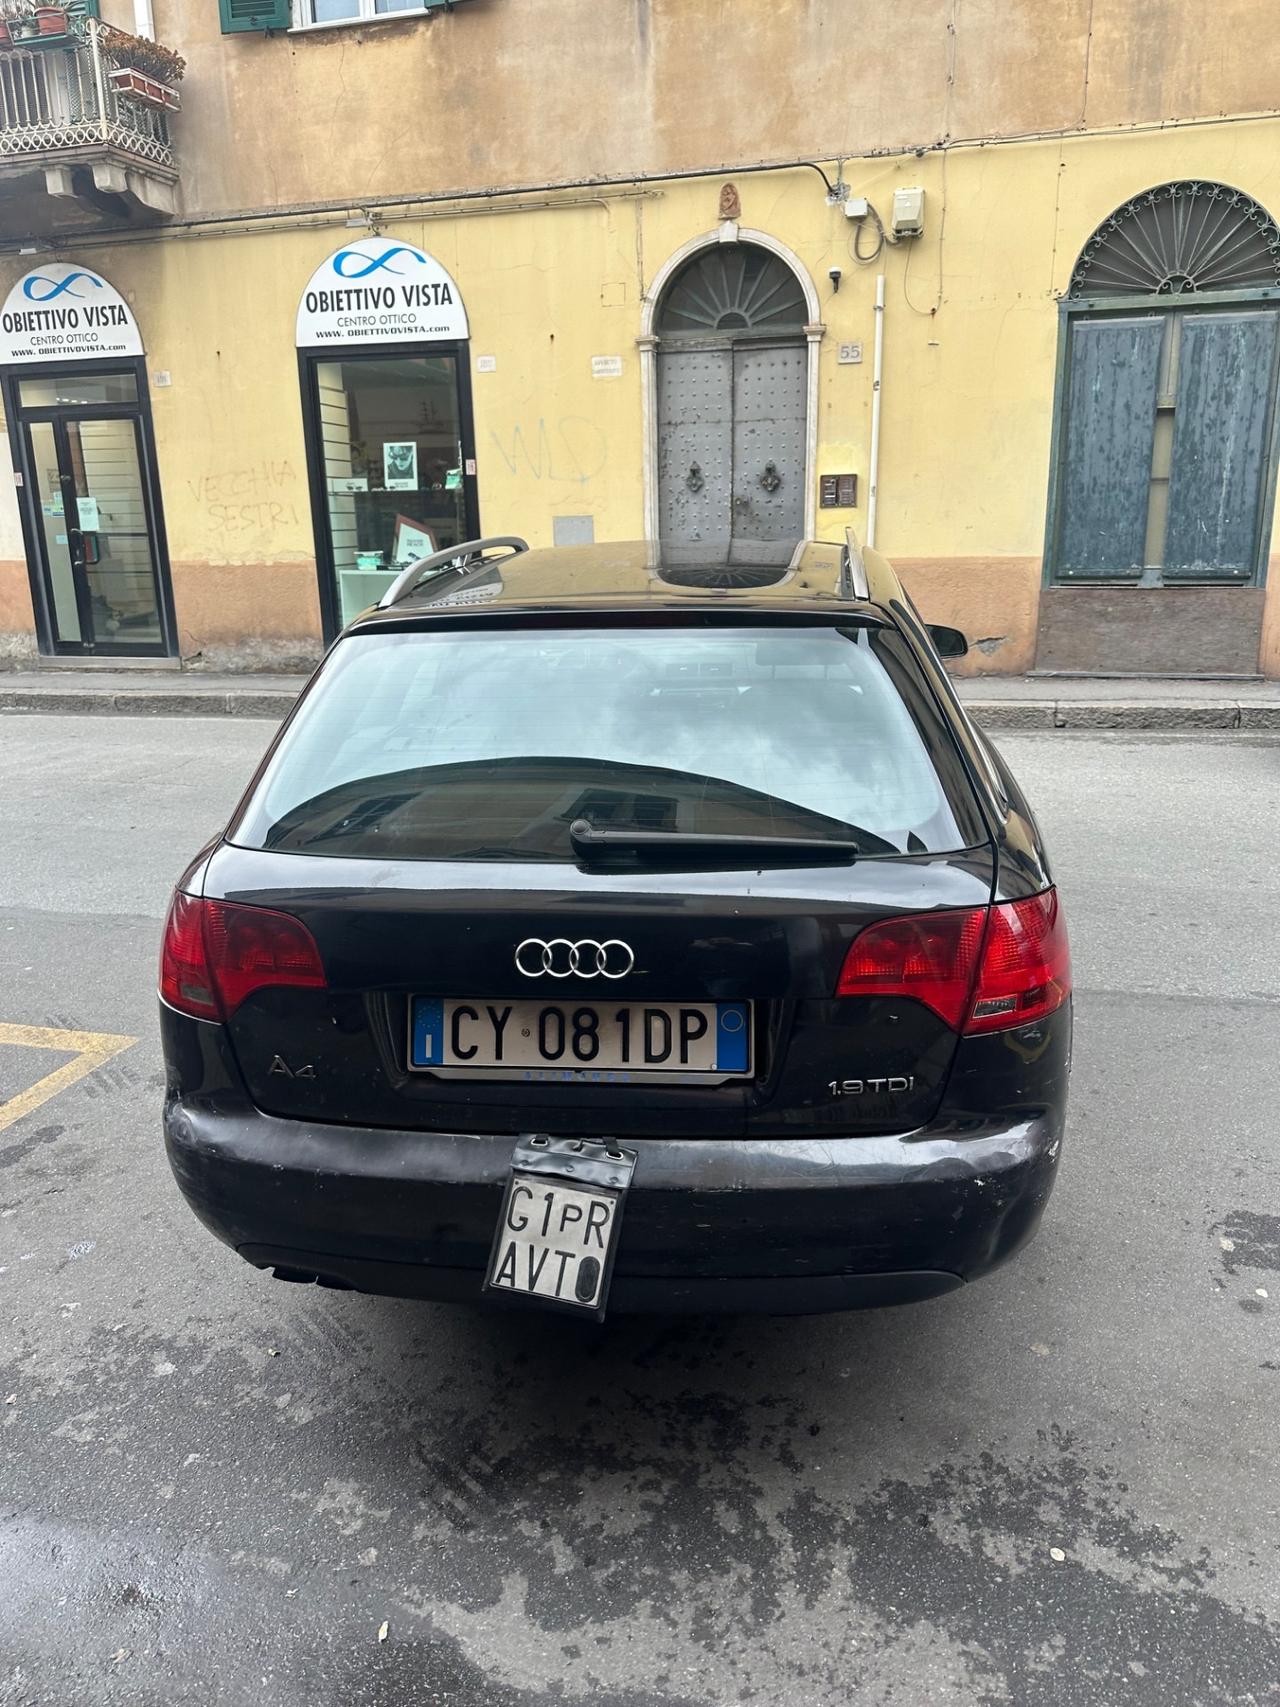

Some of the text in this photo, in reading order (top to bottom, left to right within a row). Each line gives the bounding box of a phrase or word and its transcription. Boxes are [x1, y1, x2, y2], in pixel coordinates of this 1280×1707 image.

[306, 283, 453, 313] OBIETTIVO VISTA
[2, 304, 128, 333] OBIETTIVO VISTA
[337, 313, 417, 327] CENTRO OTTICO
[30, 332, 98, 346] CENTRO OTTICO
[347, 326, 450, 337] OBIETTIVOVISTA.com
[840, 345, 860, 359] 55
[208, 502, 299, 532] SESTRI
[451, 1005, 513, 1061] CY
[268, 1054, 317, 1080] A4
[828, 1080, 864, 1096] 1.9
